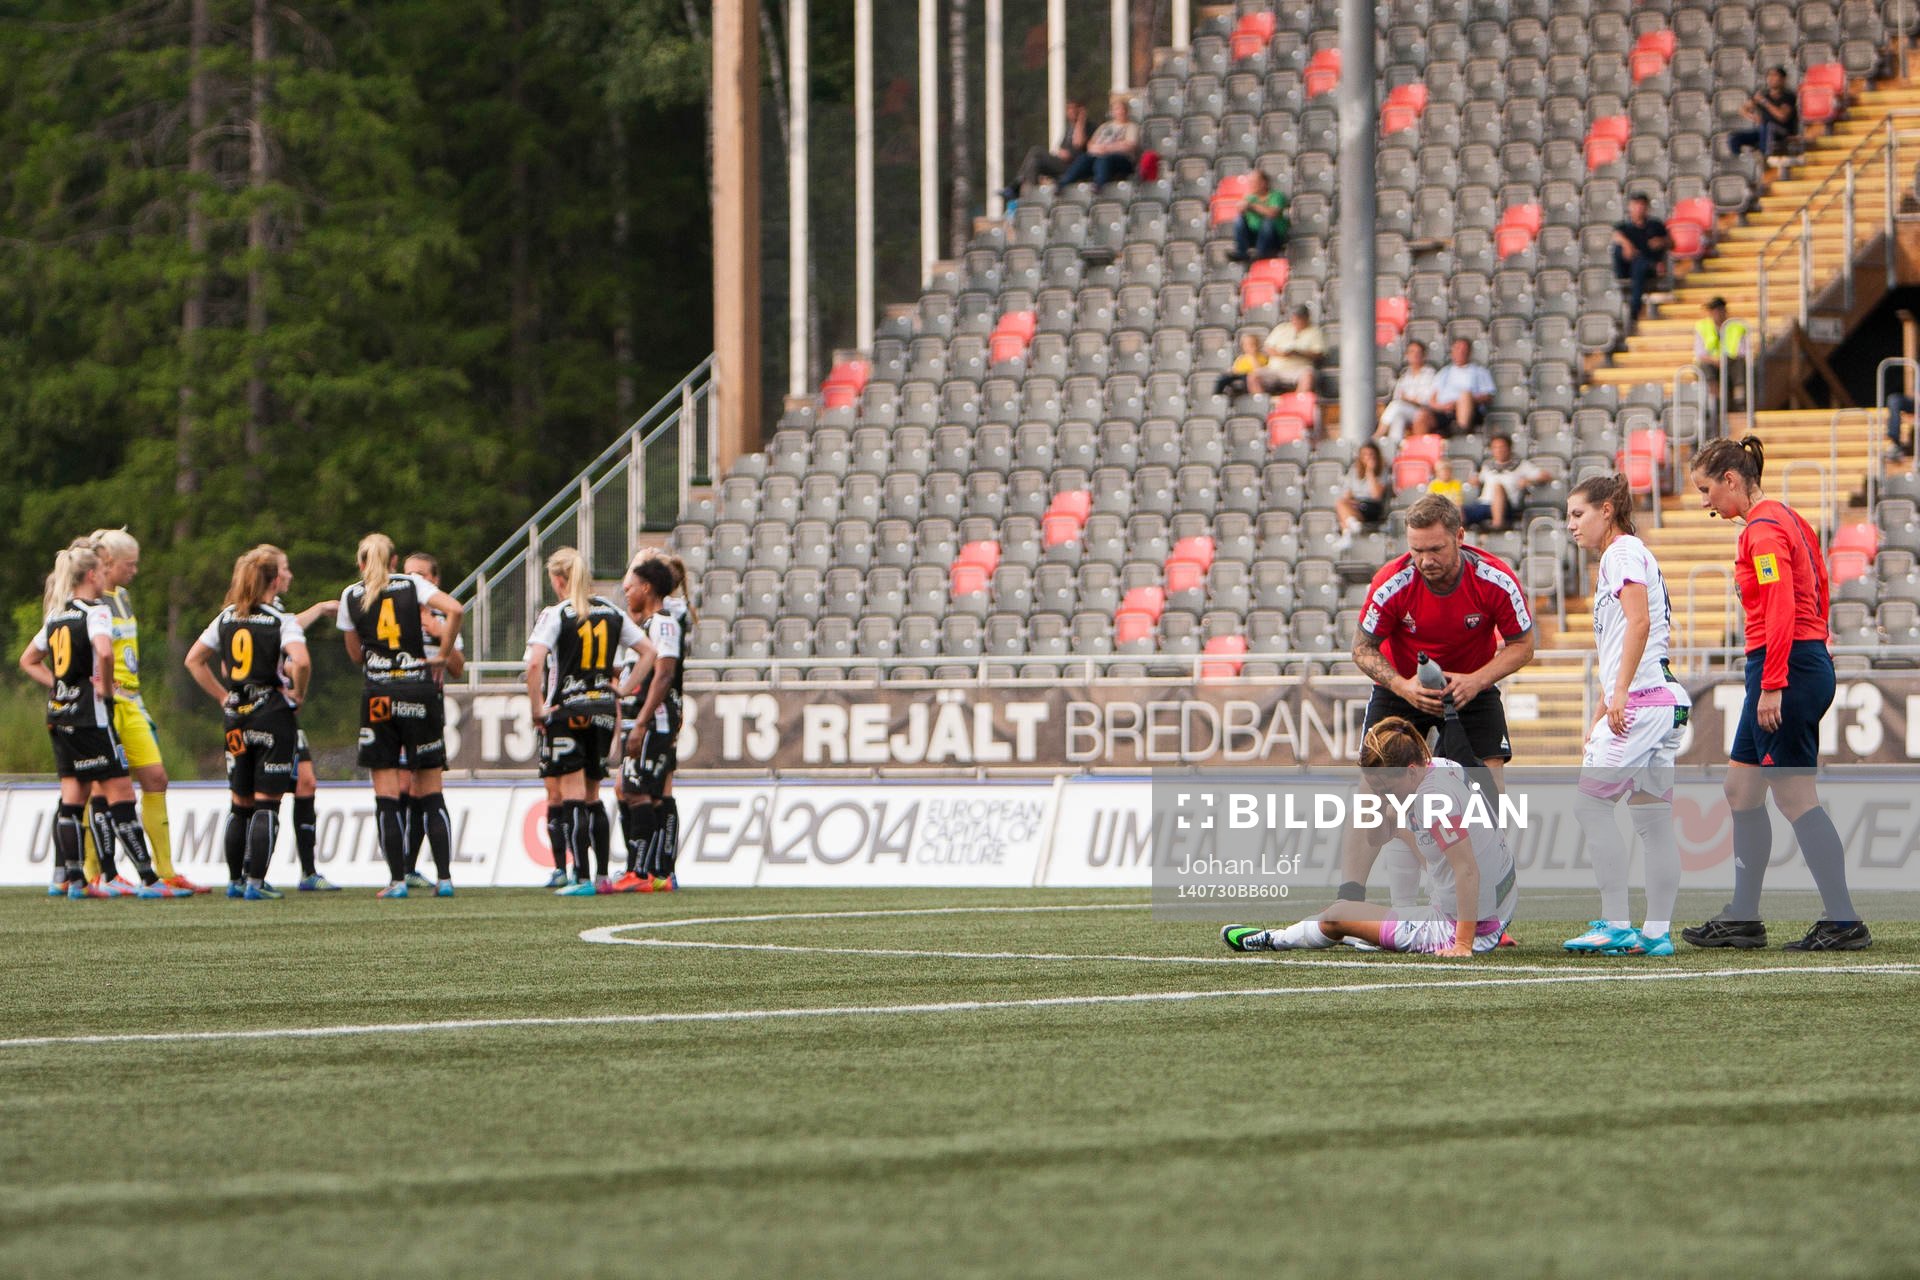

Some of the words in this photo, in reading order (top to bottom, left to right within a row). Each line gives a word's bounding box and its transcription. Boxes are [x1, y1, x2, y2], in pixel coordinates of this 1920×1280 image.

[376, 597, 401, 650] 4
[577, 618, 608, 670] 11
[231, 628, 253, 681] 9
[472, 695, 537, 762] T3
[714, 694, 781, 762] T3
[802, 688, 1051, 764] REJÄLT
[920, 820, 1003, 841] CAPITAL
[1008, 820, 1041, 841] OF
[928, 799, 1043, 821] EUROPEAN
[916, 841, 1007, 864] CULTURE
